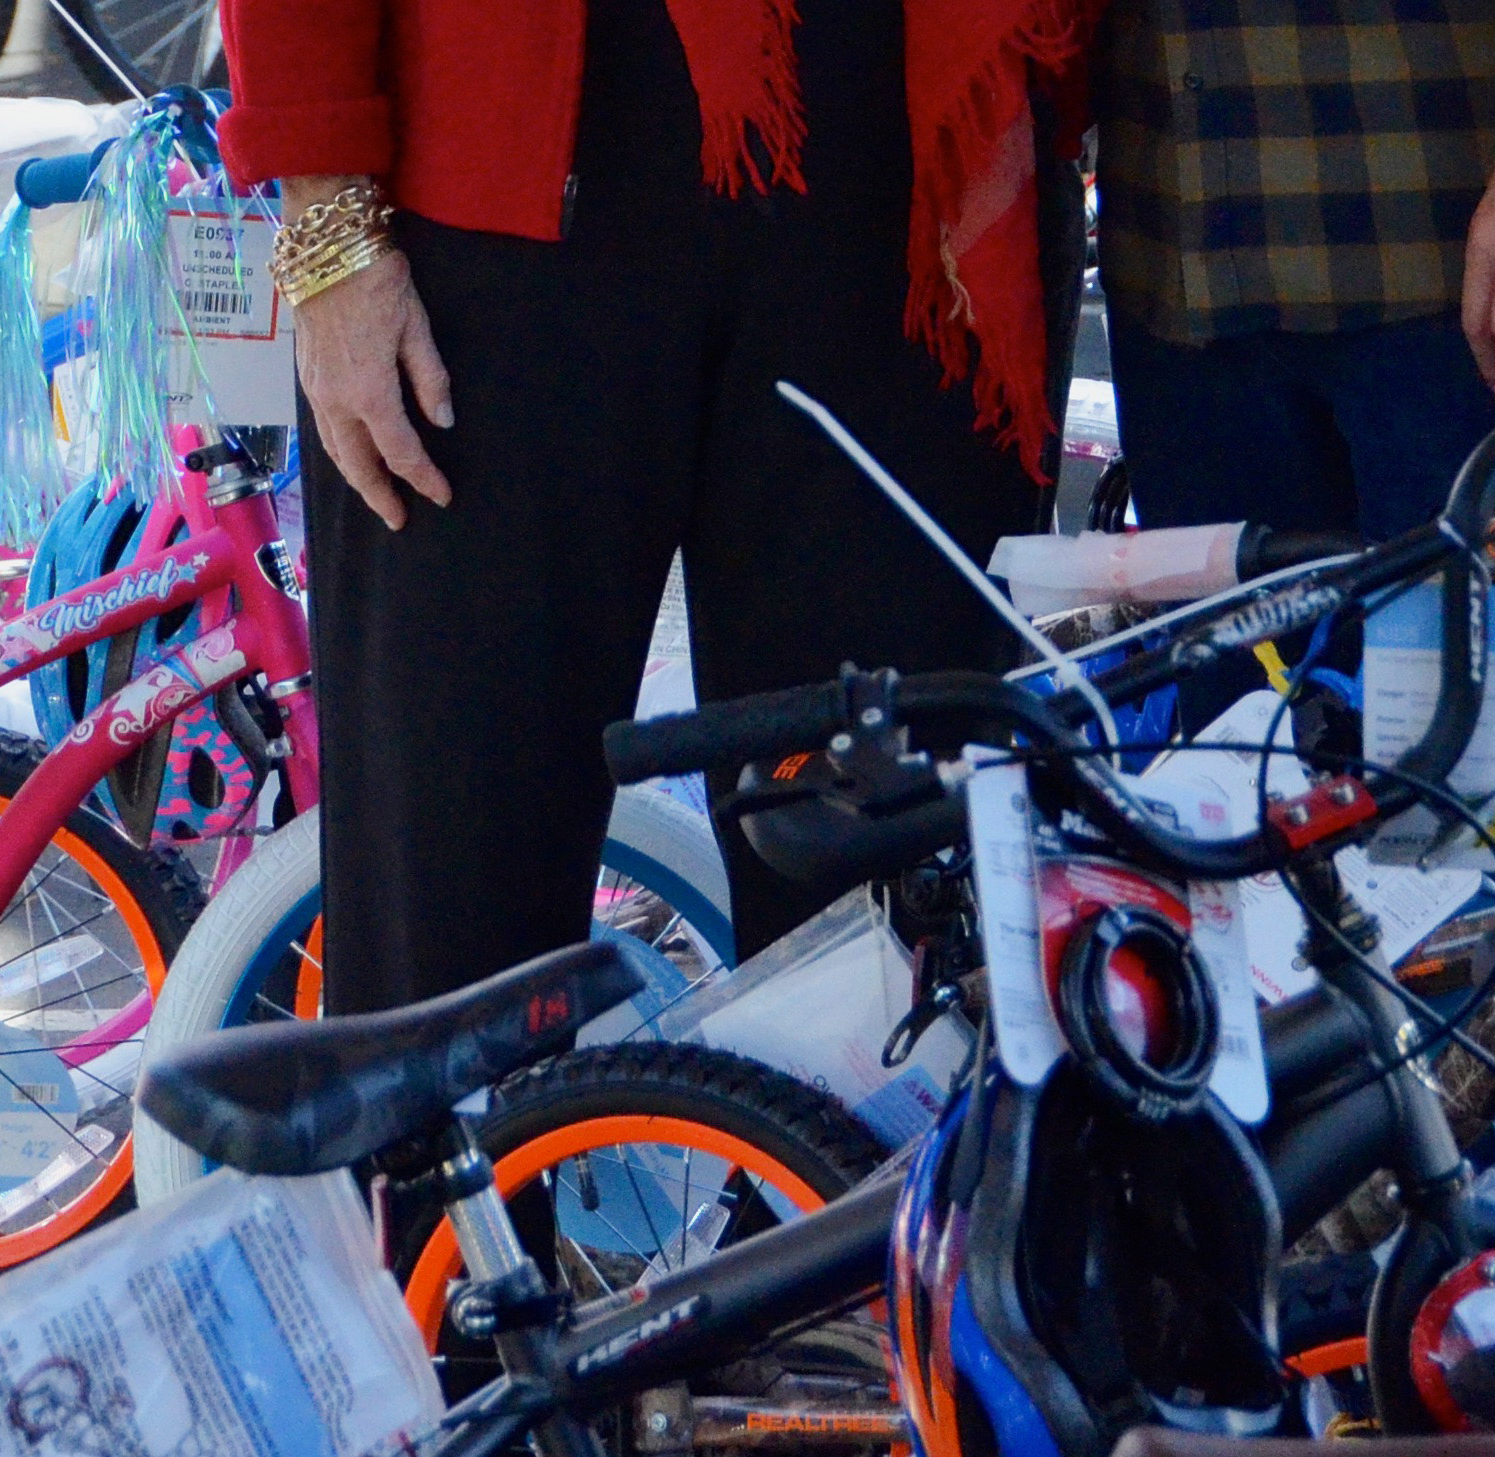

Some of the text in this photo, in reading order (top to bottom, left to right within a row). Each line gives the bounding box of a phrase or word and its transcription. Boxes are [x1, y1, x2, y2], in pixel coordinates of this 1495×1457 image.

[182, 263, 254, 277] UNSCHEDUED
[38, 557, 179, 639] Mischief
[747, 1411, 893, 1434] REALTREE
